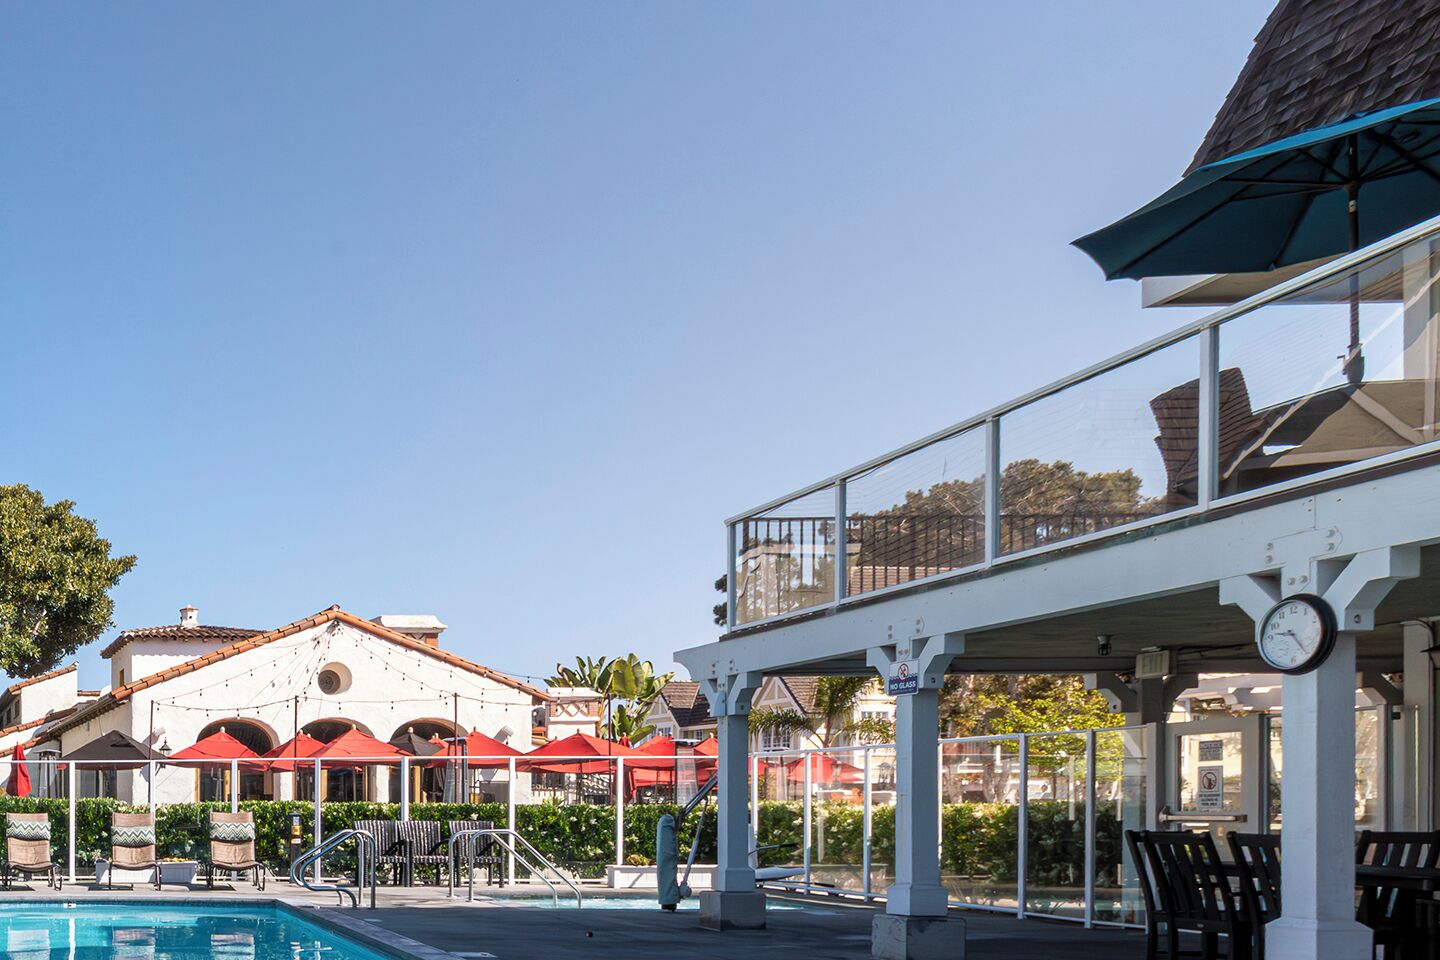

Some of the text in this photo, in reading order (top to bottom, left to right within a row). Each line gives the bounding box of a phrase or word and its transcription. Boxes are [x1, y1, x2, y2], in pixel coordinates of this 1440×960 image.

[1290, 606, 1298, 614] 12
[1270, 622, 1280, 631] 10
[899, 681, 916, 689] GLASS
